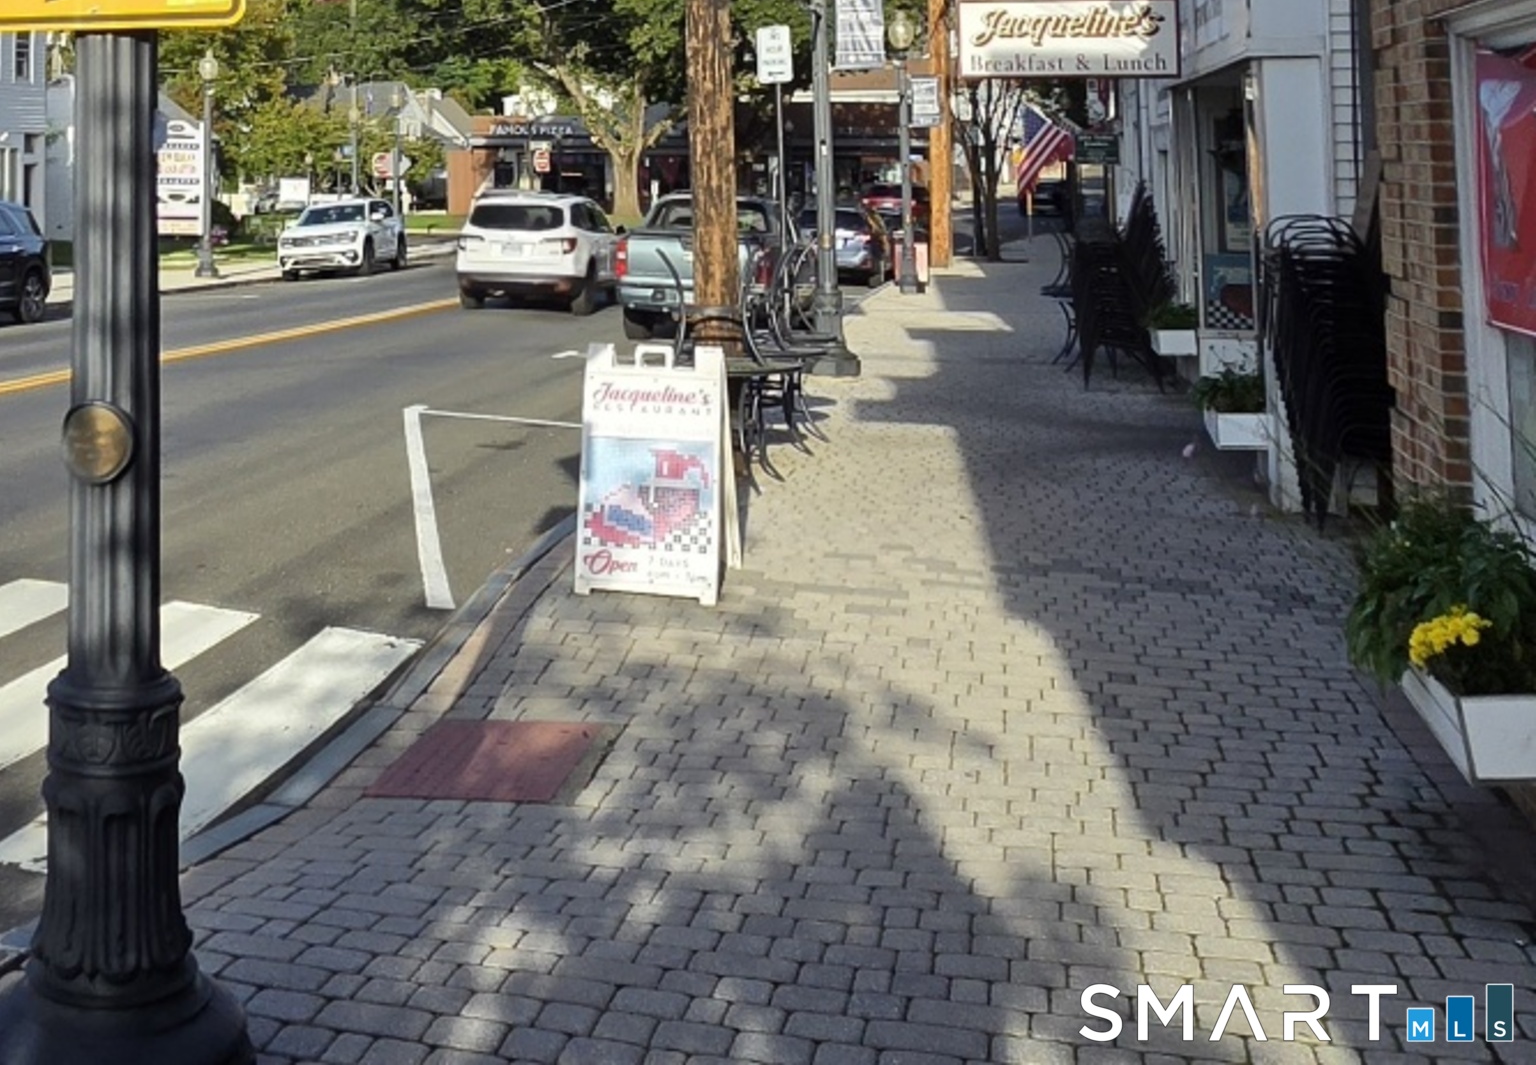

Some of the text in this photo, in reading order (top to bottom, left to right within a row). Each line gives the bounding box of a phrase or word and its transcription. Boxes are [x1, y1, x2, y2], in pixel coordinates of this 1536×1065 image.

[972, 5, 1165, 47] Jacqueline's
[970, 52, 1168, 73] Breakfast & Lunch
[592, 382, 713, 407] Jacqueline's
[583, 549, 638, 575] Open
